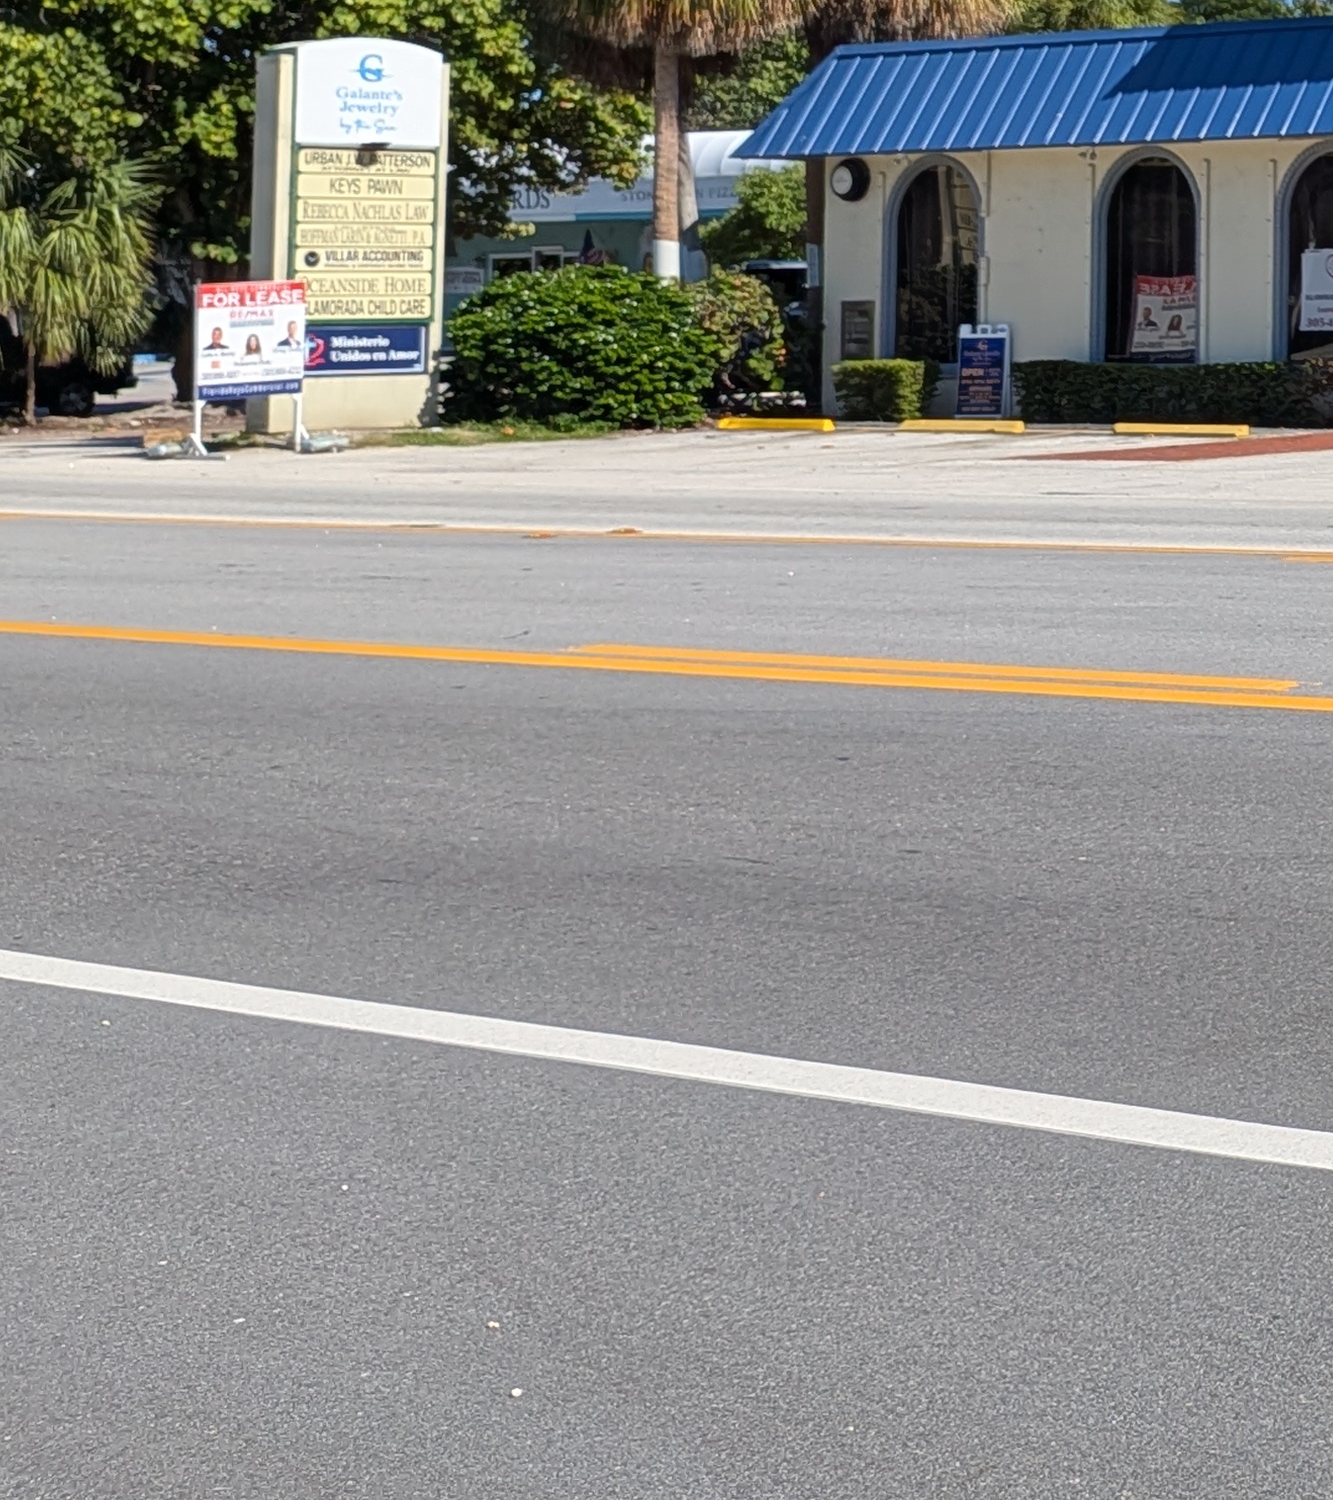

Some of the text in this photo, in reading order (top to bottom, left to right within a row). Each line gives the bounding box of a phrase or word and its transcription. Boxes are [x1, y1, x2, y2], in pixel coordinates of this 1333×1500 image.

[335, 86, 403, 101] Galante's
[339, 101, 399, 117] Jewelry
[304, 151, 343, 166] URBAN
[371, 153, 431, 168] ATTERSON
[329, 178, 403, 194] KEYS PAWN
[302, 200, 349, 220] REBECCA
[405, 202, 430, 220] LAW
[325, 250, 424, 262] VILLAR ACCOUNTING
[384, 276, 427, 294] HOME
[201, 288, 304, 308] FOR LEASE
[367, 299, 397, 316] CHILD
[400, 298, 426, 316] CARE
